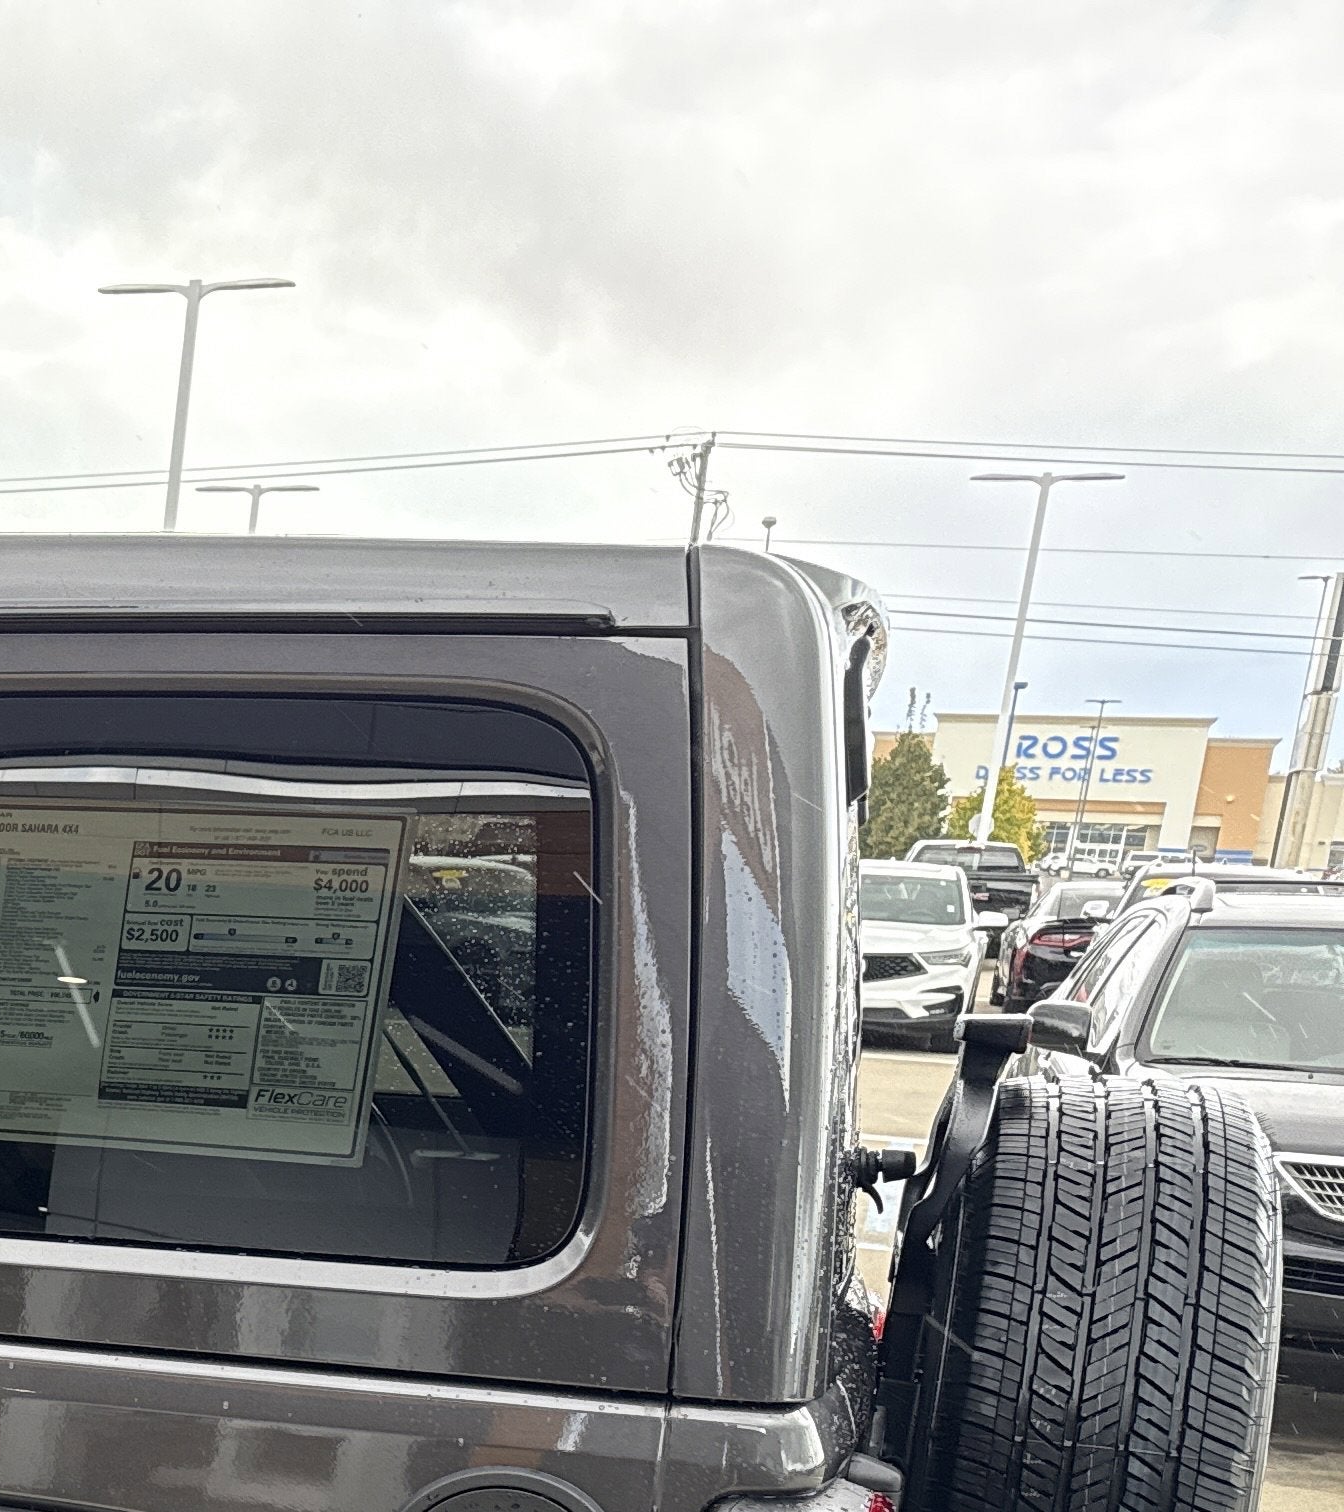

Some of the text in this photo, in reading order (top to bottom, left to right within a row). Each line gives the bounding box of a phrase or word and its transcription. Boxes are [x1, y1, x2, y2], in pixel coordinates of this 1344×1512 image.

[1015, 735, 1120, 760] ROSS
[975, 765, 1154, 784] DSS FOR LESS
[20, 823, 59, 834] SAHARA
[61, 824, 80, 835] 4X4
[321, 828, 339, 836] FCA
[153, 845, 171, 853] Fuel
[172, 846, 210, 856] Economy
[186, 868, 207, 876] MPG
[331, 866, 369, 877] spend
[144, 867, 183, 893] 20
[313, 877, 370, 894] $4,000
[144, 899, 158, 908] 5.0
[160, 918, 185, 927] cost
[125, 928, 179, 944] $2,500
[117, 969, 201, 982] fueleconomy.gov
[254, 1088, 348, 1109] FlexCare
